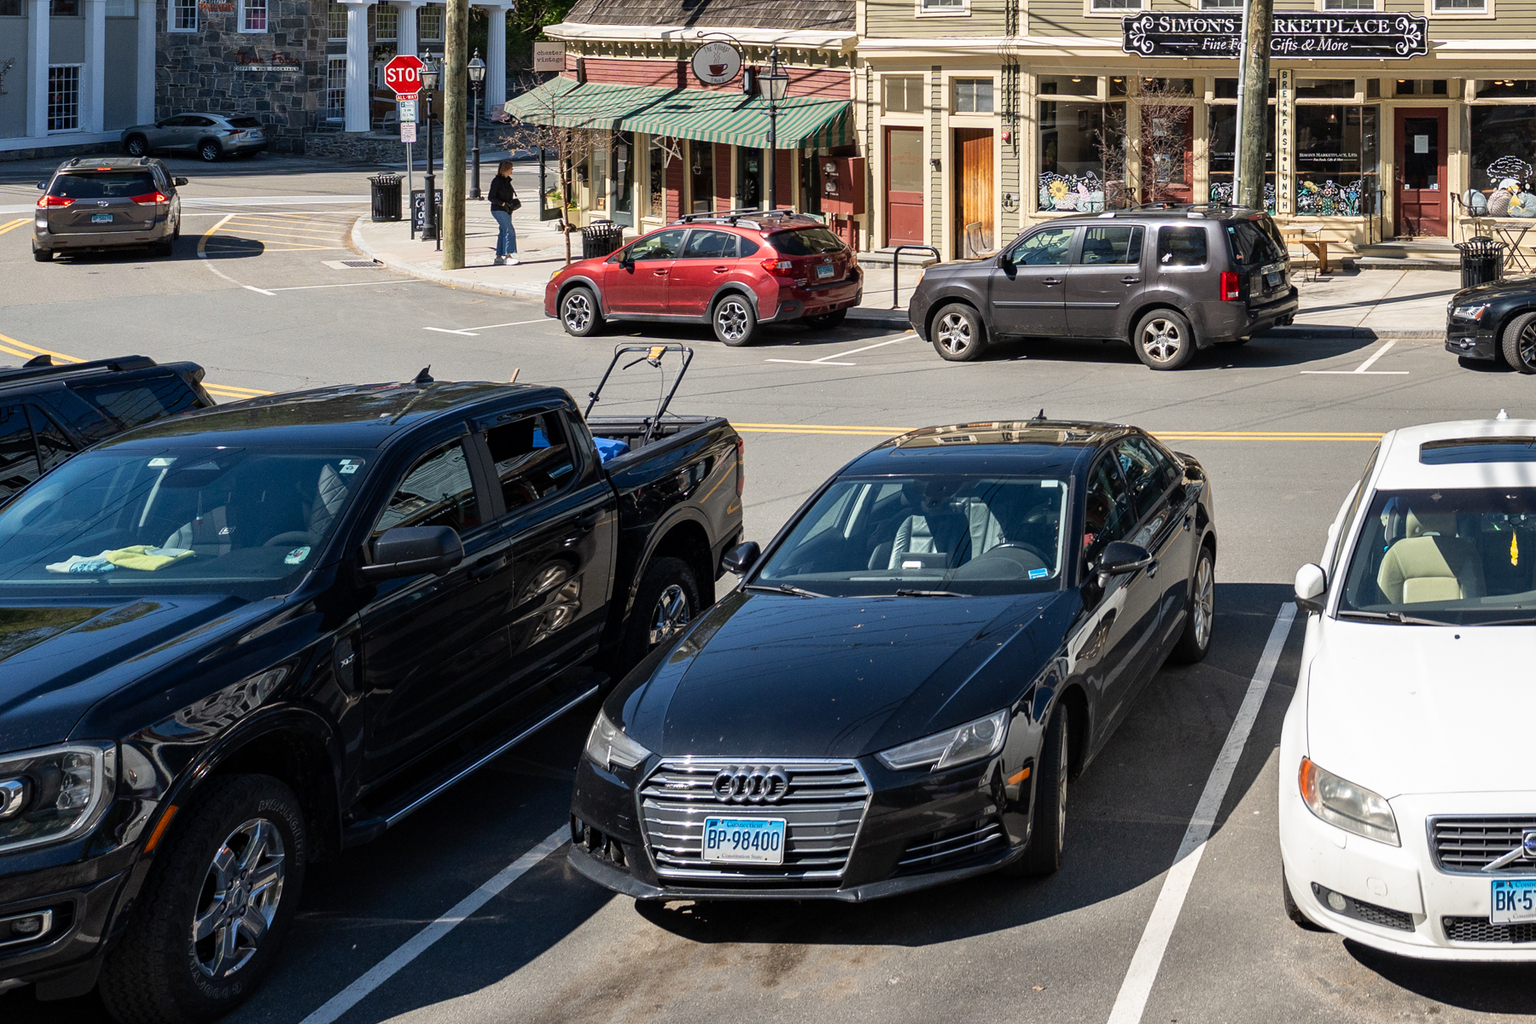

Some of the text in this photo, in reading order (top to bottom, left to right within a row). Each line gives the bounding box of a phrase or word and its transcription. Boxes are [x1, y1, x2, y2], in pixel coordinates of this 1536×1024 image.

[1159, 16, 1390, 33] SIMON'S RKETPLACE
[1202, 38, 1226, 49] Fine
[1270, 38, 1298, 54] Gifts
[1301, 39, 1314, 50] &
[1316, 39, 1348, 51] More
[726, 820, 763, 829] Connecticut
